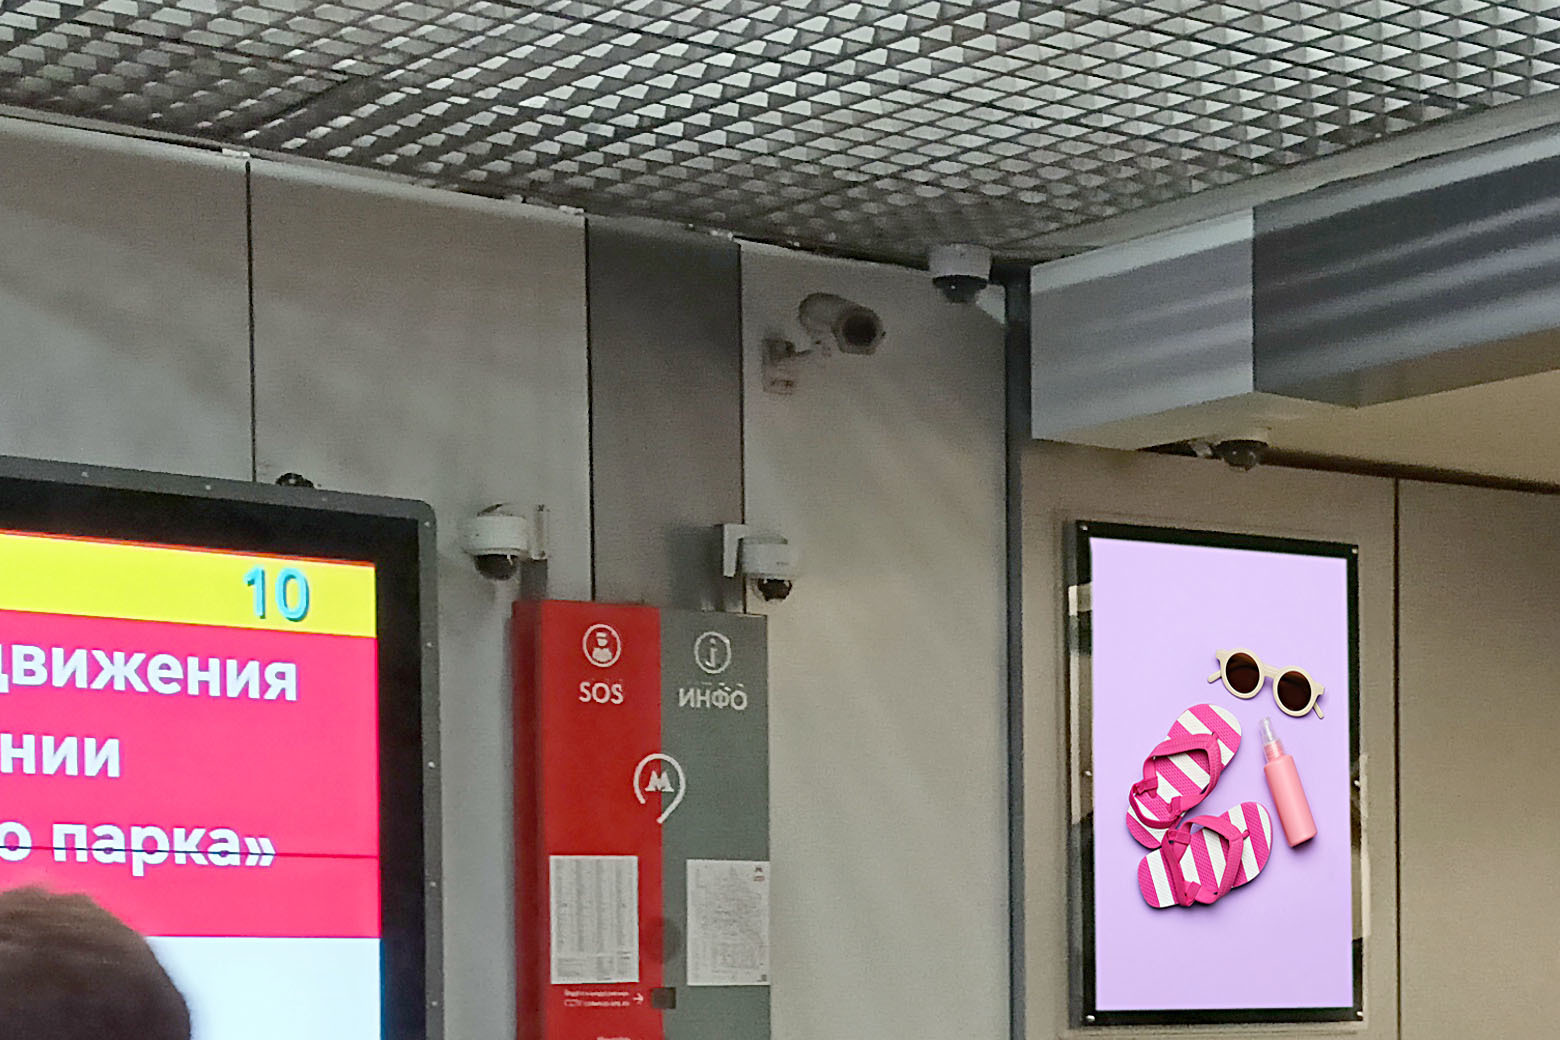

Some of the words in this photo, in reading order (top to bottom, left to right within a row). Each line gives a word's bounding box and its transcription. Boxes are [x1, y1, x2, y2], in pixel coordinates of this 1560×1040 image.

[243, 565, 311, 623] 10
[578, 681, 625, 705] SOS
[678, 687, 749, 711] ИНФО
[51, 823, 277, 877] парка»
